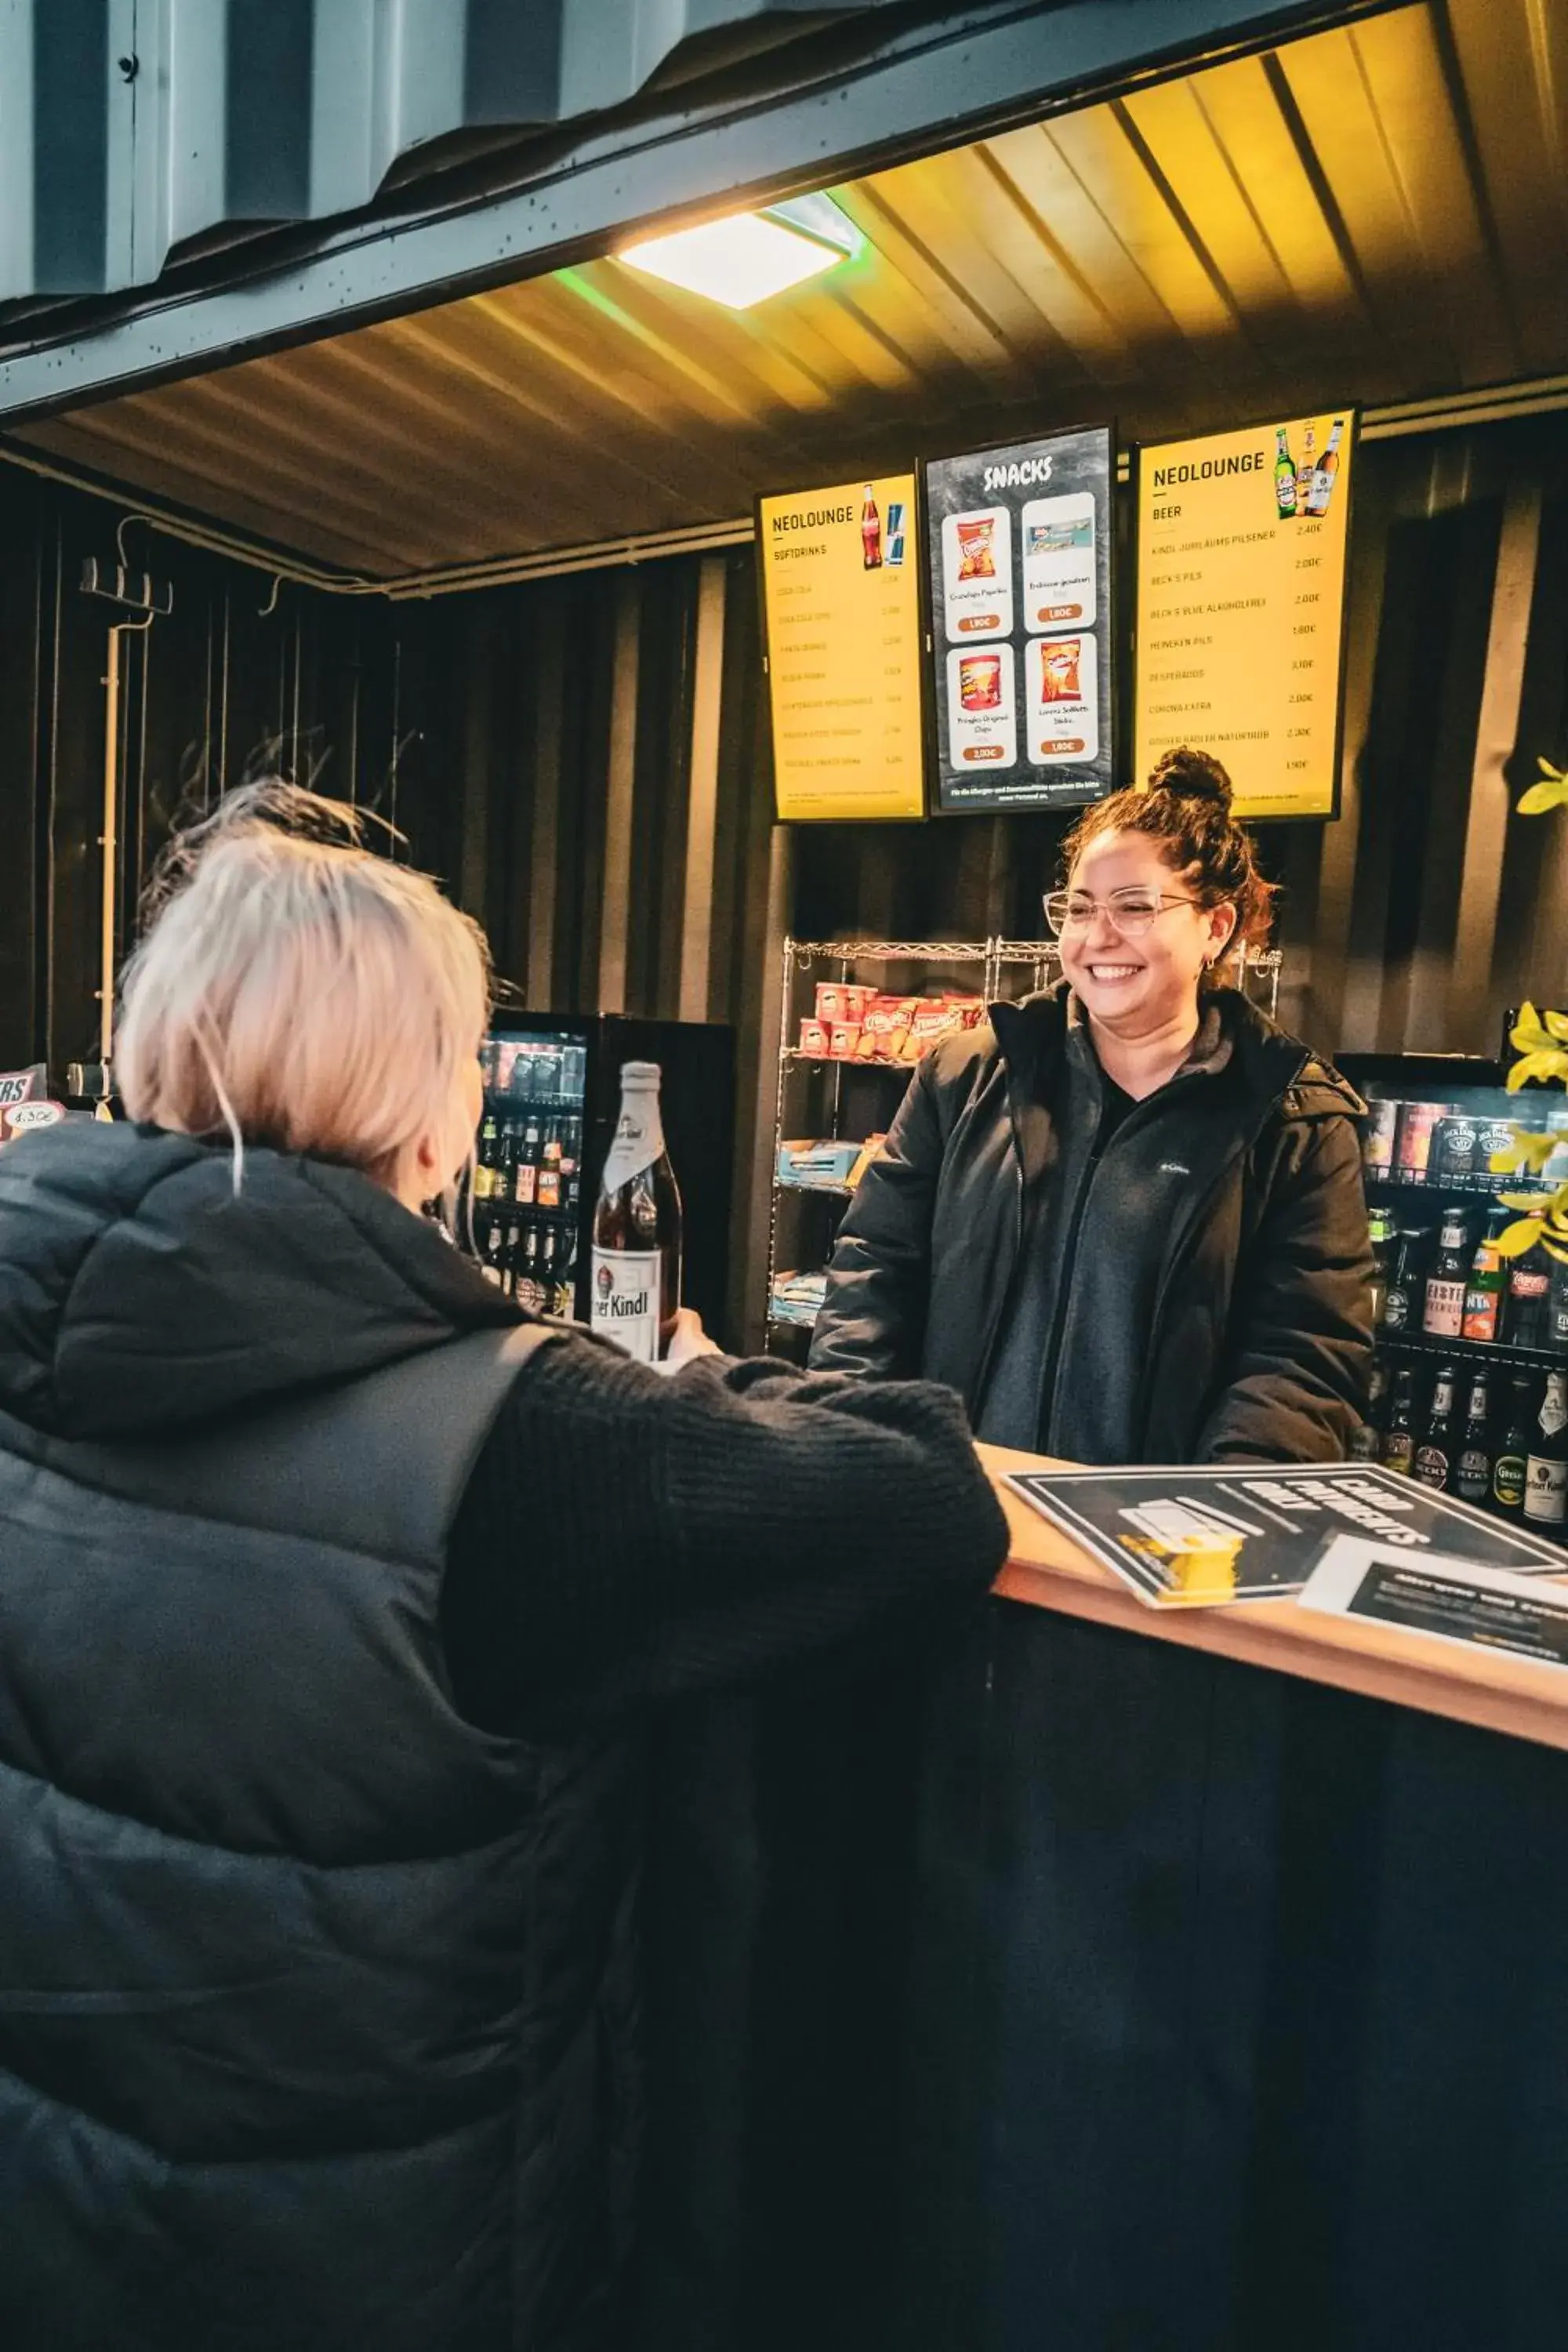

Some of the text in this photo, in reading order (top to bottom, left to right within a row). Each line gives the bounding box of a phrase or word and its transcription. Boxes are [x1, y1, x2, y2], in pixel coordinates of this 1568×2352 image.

[984, 456, 1053, 492] SNACKS
[1154, 452, 1265, 487] NEOLOUNGE
[772, 506, 853, 532] NEOLOUNGE
[1153, 506, 1181, 520] BEER
[774, 544, 827, 561] SOFTDRINKS
[0, 1077, 27, 1103] RS
[611, 1291, 648, 1317] Kindl
